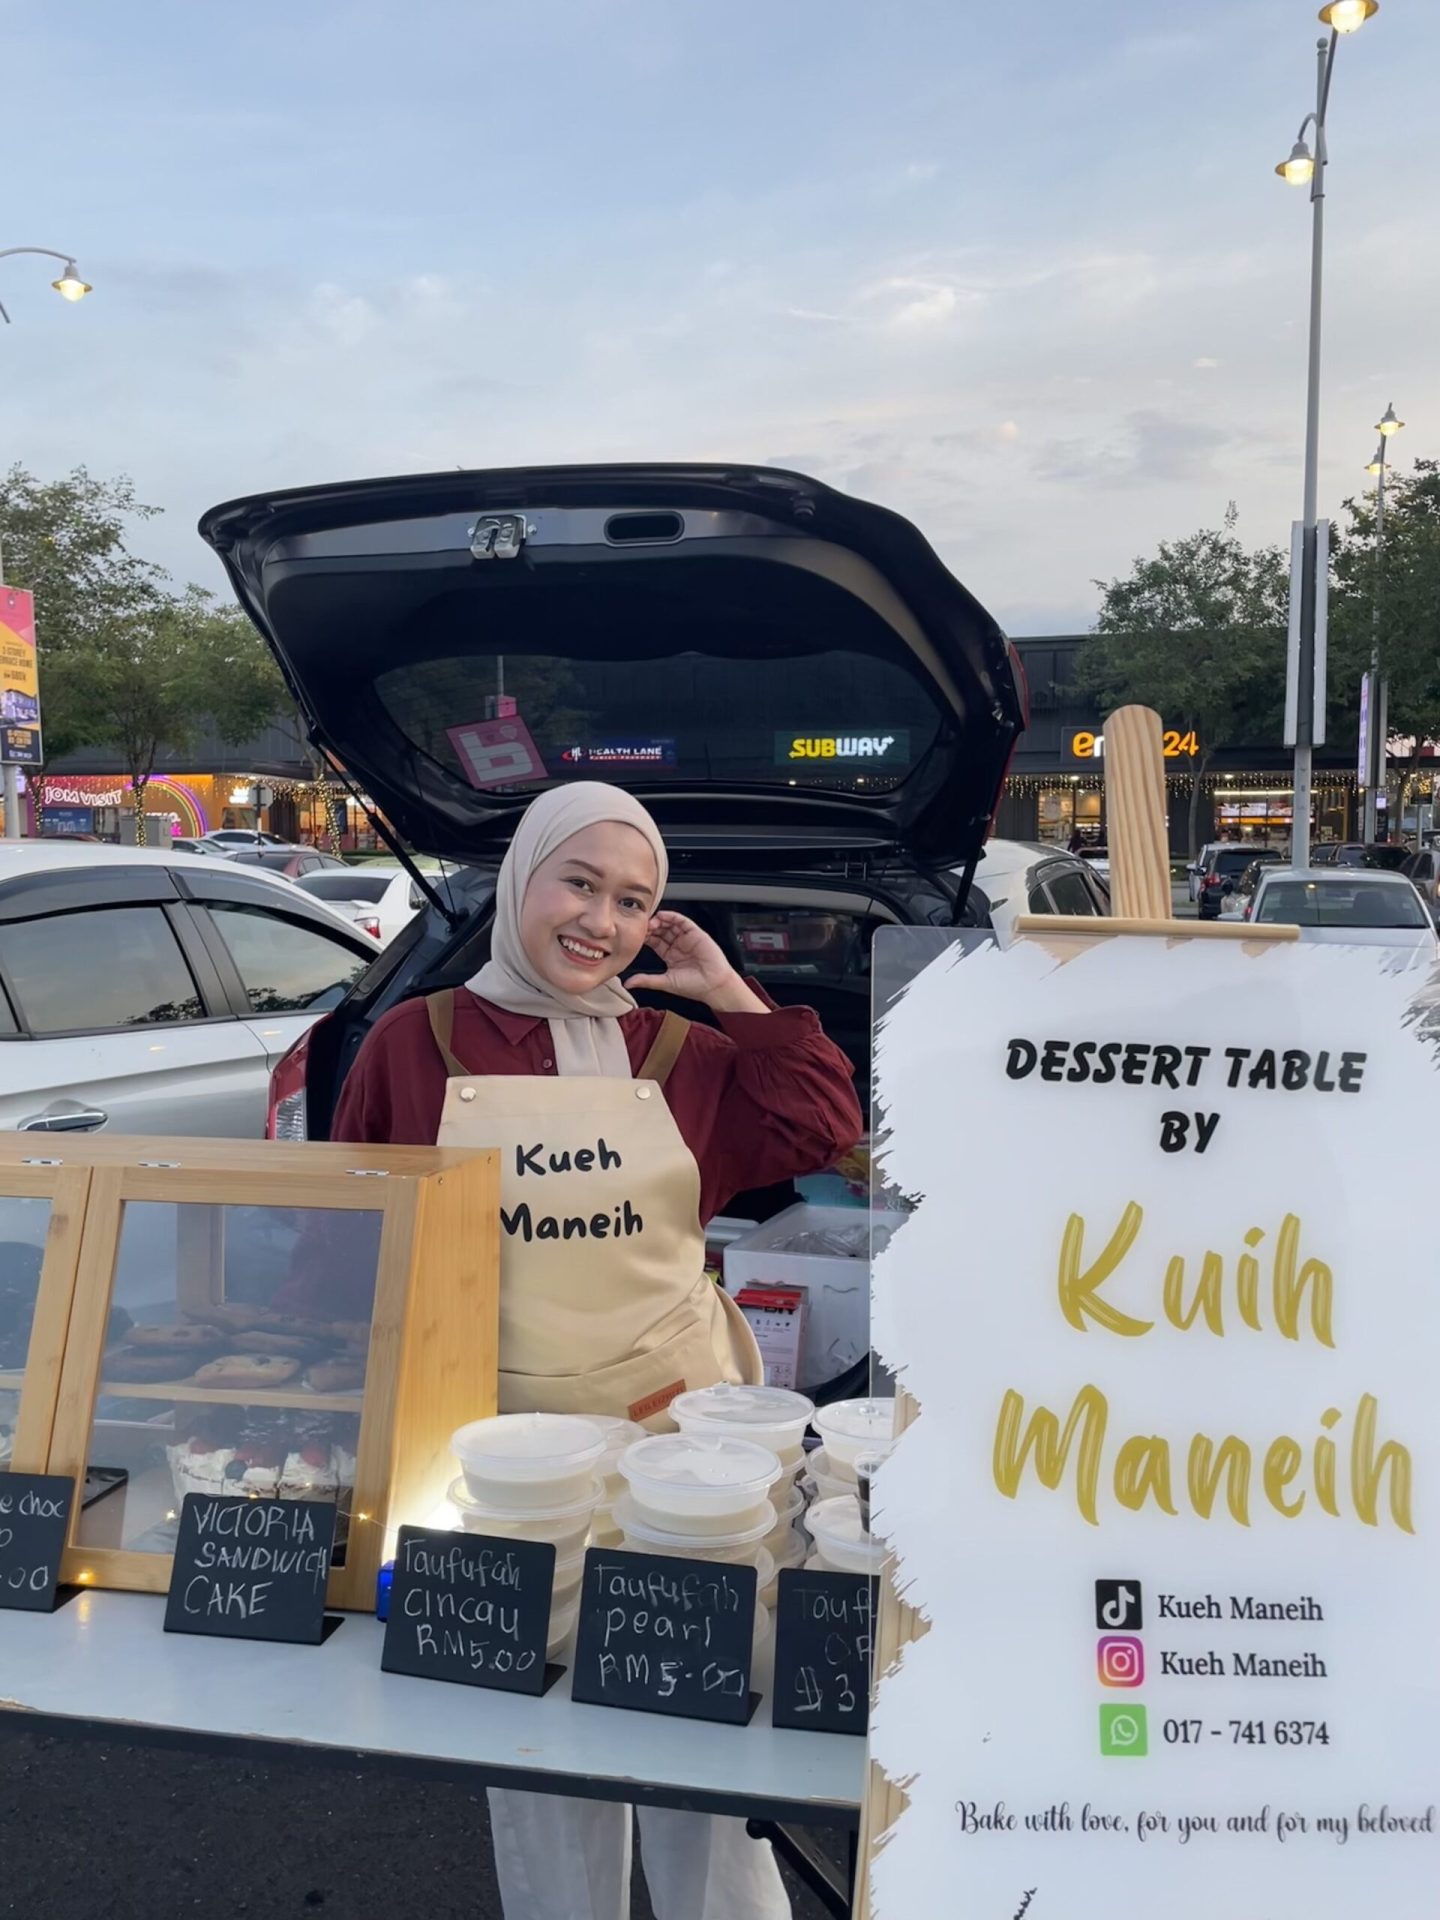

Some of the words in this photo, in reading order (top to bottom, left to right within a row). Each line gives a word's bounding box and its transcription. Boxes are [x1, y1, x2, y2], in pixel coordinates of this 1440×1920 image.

[633, 746, 663, 756] LANE
[788, 736, 896, 758] SUBWAY
[44, 786, 80, 805] JOM
[81, 788, 122, 807] VISIT
[1006, 1038, 1211, 1090] DESSERT
[1224, 1047, 1367, 1093] TABLE
[1160, 1111, 1220, 1153] BY
[516, 1138, 622, 1176] Kueh
[500, 1200, 643, 1242] Maneih
[1058, 1200, 1336, 1349] Kuih
[992, 1384, 1416, 1535] Maneih
[193, 1502, 314, 1544] VICTORIA
[194, 1541, 327, 1593] SANDWICH
[184, 1575, 273, 1619] CAKE
[1158, 1594, 1222, 1619] Kueh
[1229, 1596, 1324, 1621] Maneih
[1160, 1651, 1225, 1676] Kueh
[1232, 1653, 1328, 1678] Maneih
[1163, 1719, 1203, 1744] 017
[1228, 1720, 1266, 1744] 741
[1274, 1721, 1330, 1745] 6374
[955, 1800, 1017, 1834] Bake
[1024, 1801, 1074, 1832] with
[1081, 1803, 1129, 1834] love,
[1136, 1809, 1171, 1842] for
[1177, 1815, 1219, 1844] you
[1226, 1804, 1271, 1833] and
[1276, 1809, 1309, 1842] for
[1315, 1815, 1349, 1844] my
[1357, 1803, 1436, 1834] beloved
